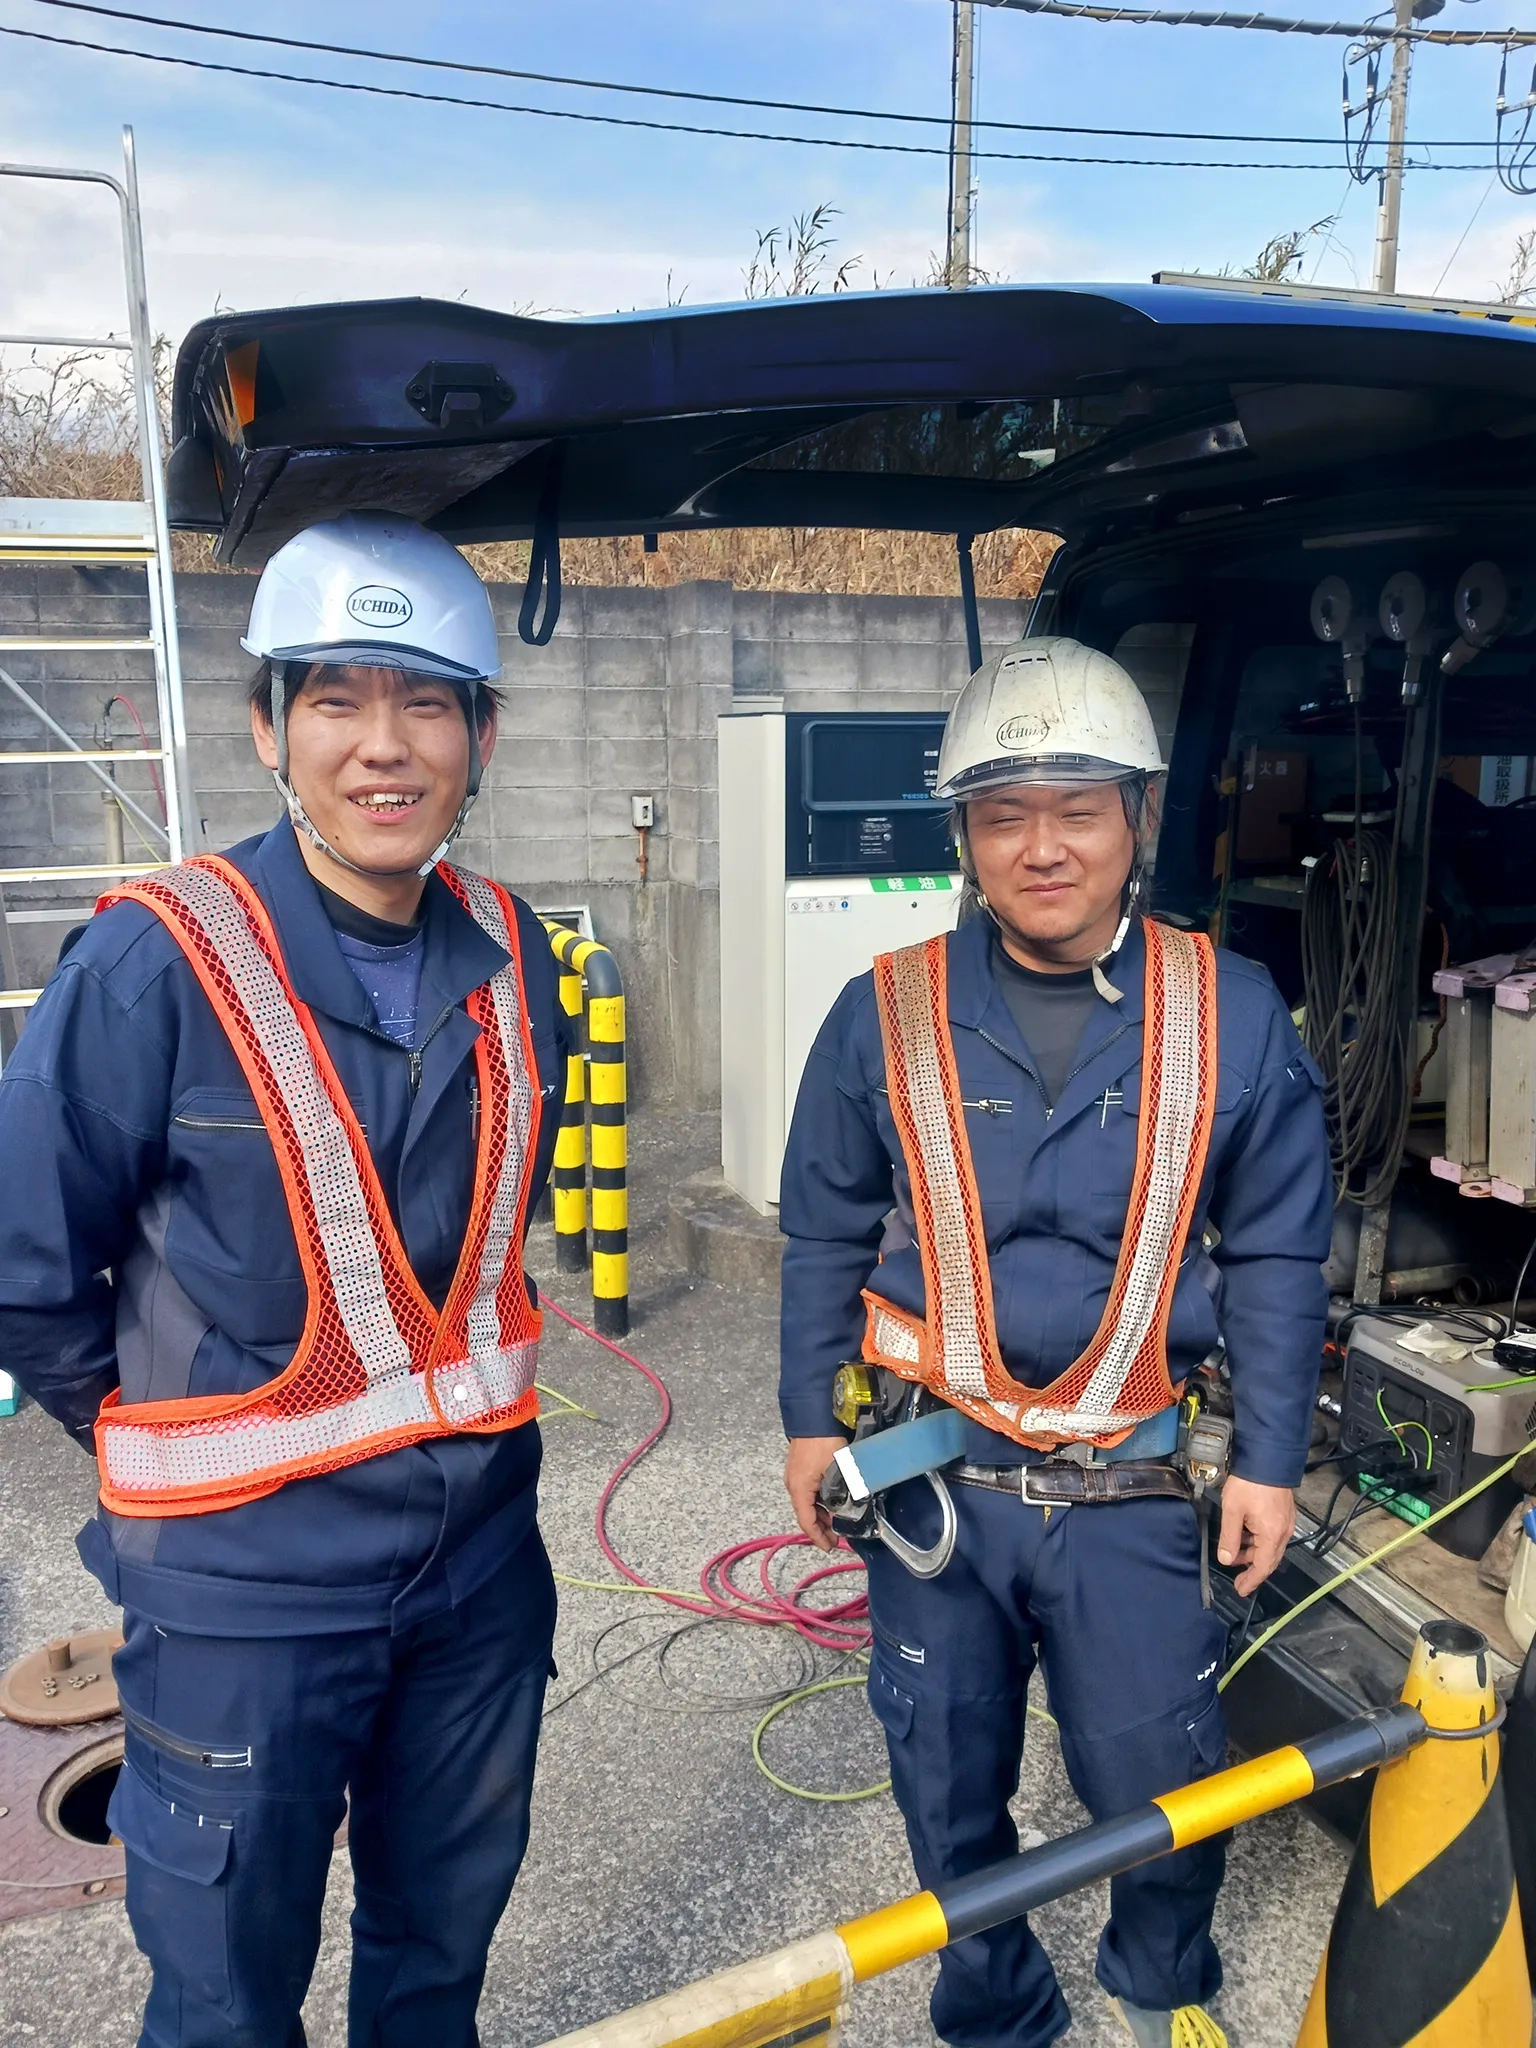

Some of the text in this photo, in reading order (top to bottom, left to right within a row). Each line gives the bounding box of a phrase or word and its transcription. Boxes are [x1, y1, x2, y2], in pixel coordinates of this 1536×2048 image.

[351, 598, 407, 616] UCHIDA
[886, 876, 937, 891] 軽油
[1392, 1356, 1425, 1377] ECOFLOW
